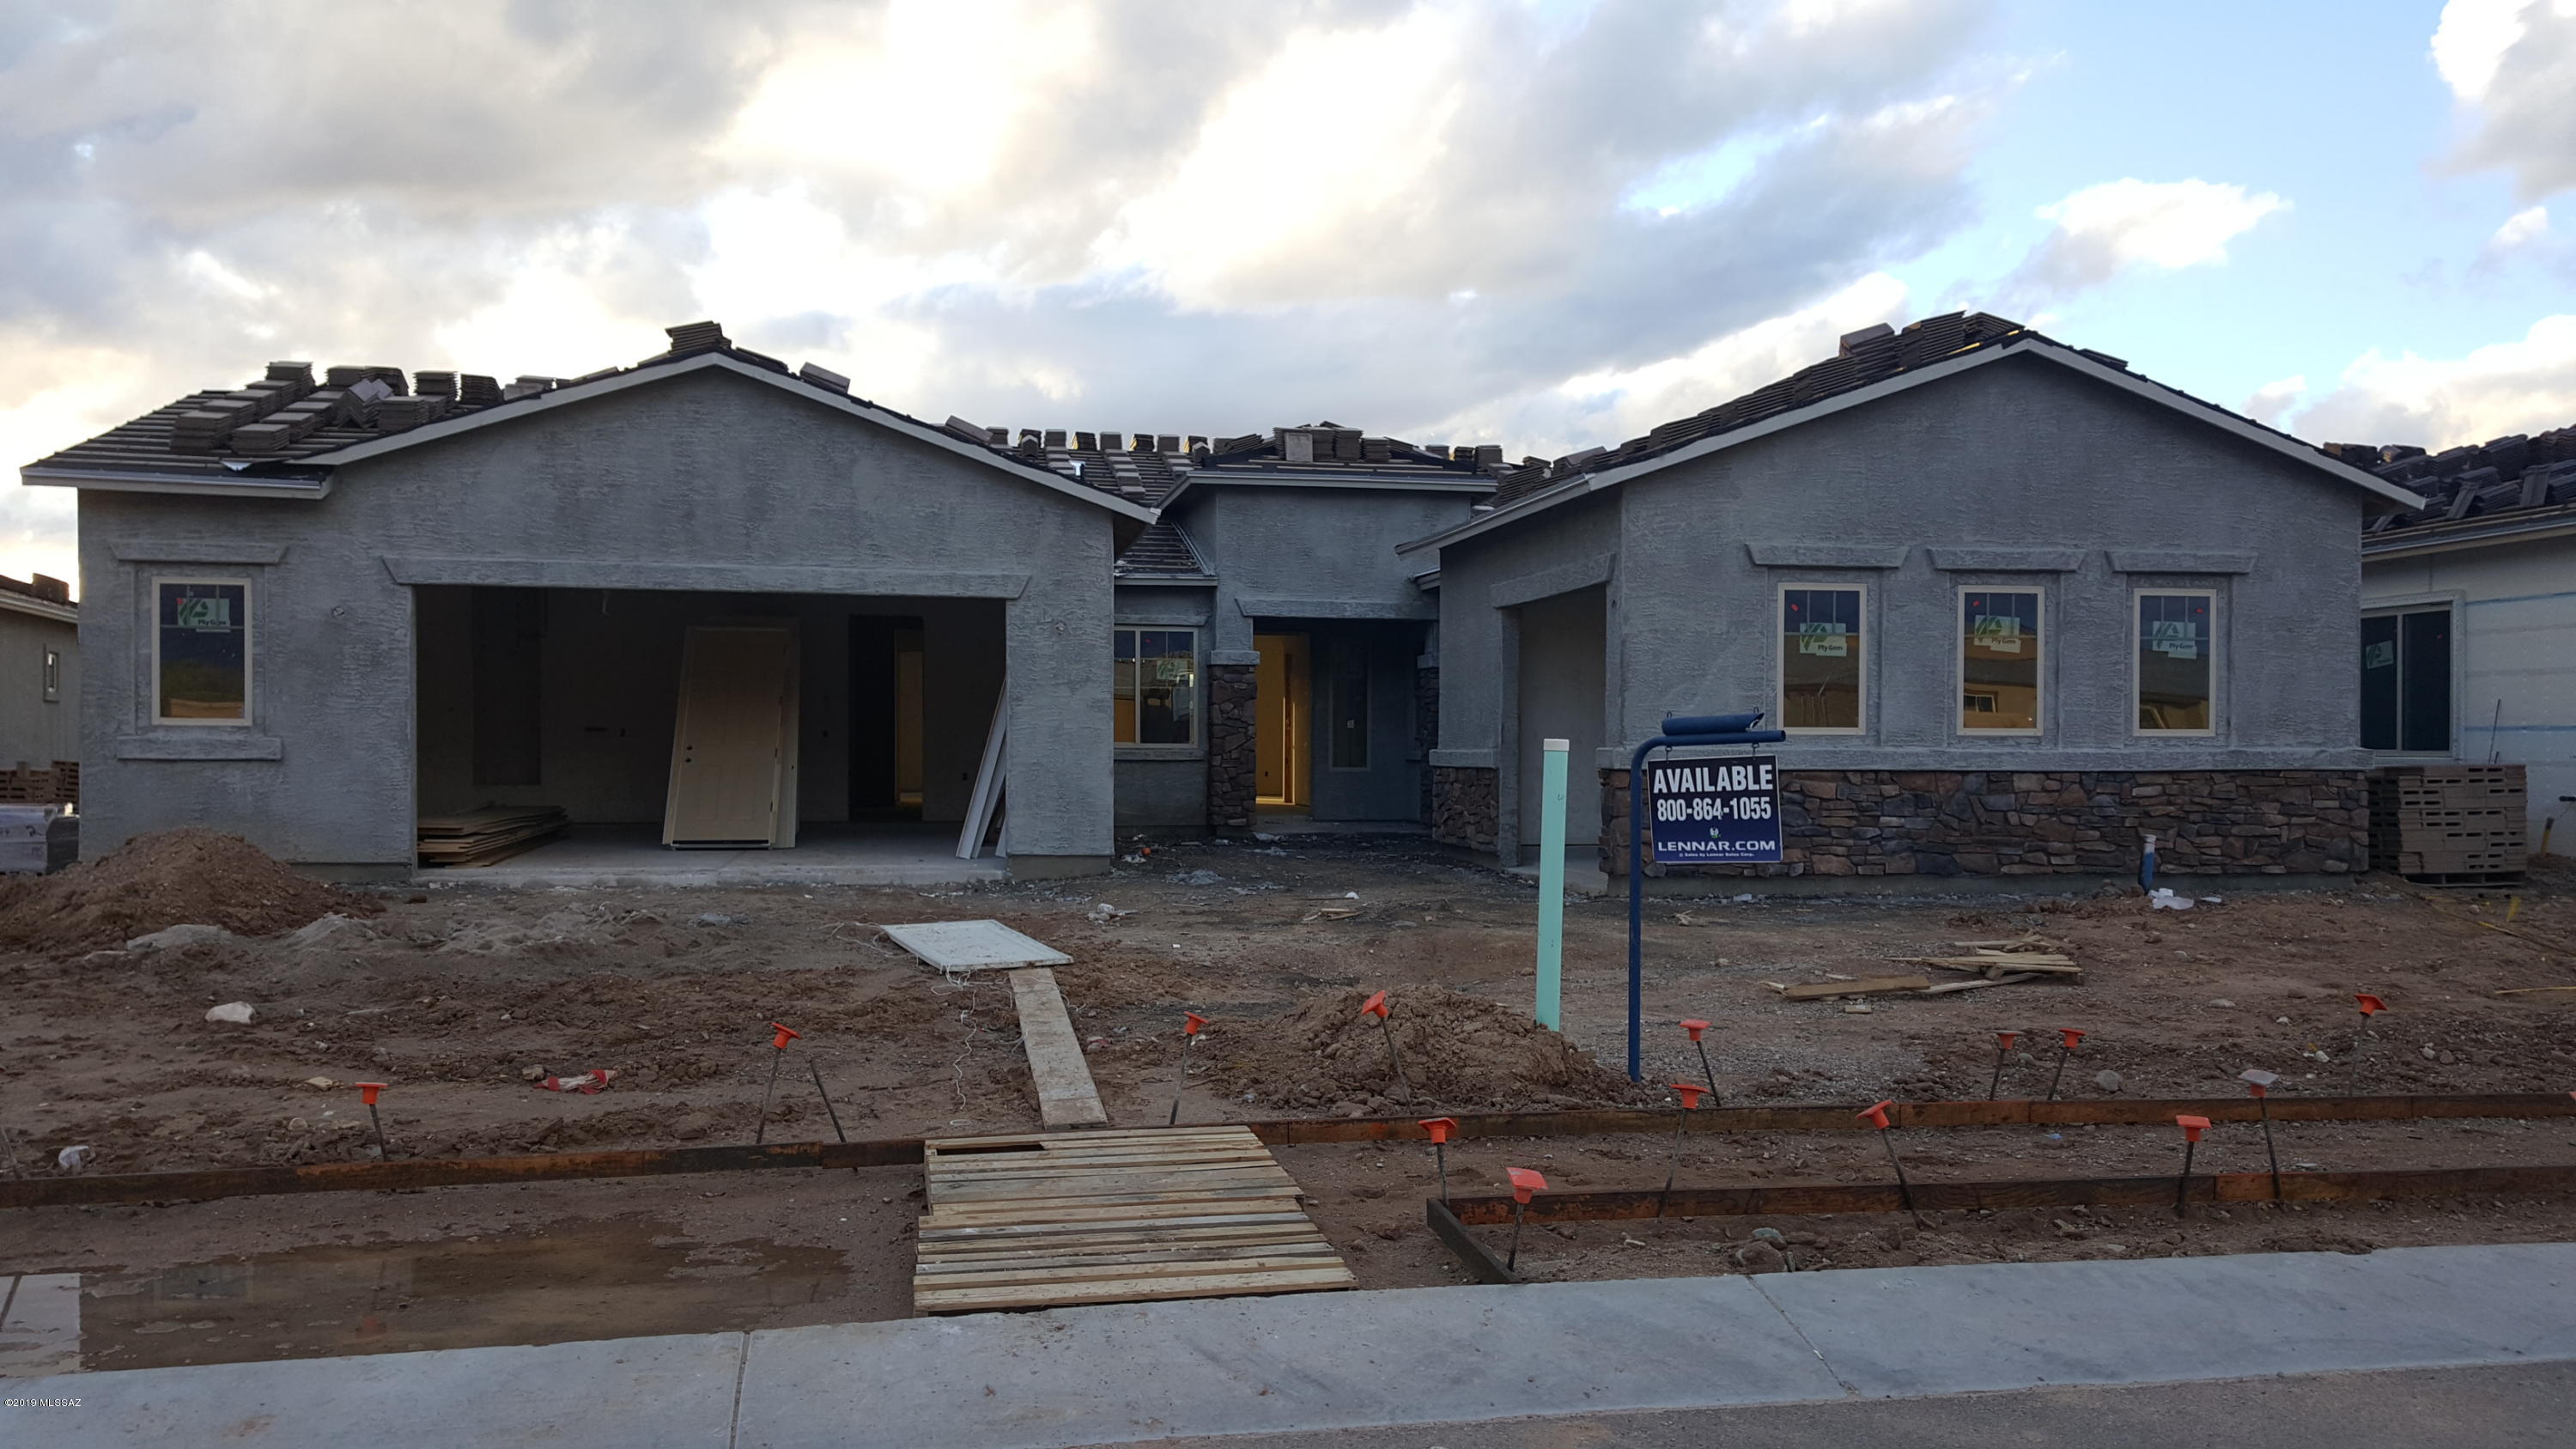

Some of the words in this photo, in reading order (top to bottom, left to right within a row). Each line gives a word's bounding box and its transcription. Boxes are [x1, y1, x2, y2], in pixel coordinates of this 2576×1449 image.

[1653, 764, 1773, 794] AVAILABLE
[1657, 796, 1771, 822] 800-864-1055
[1658, 841, 1776, 851] LENNAR.COM
